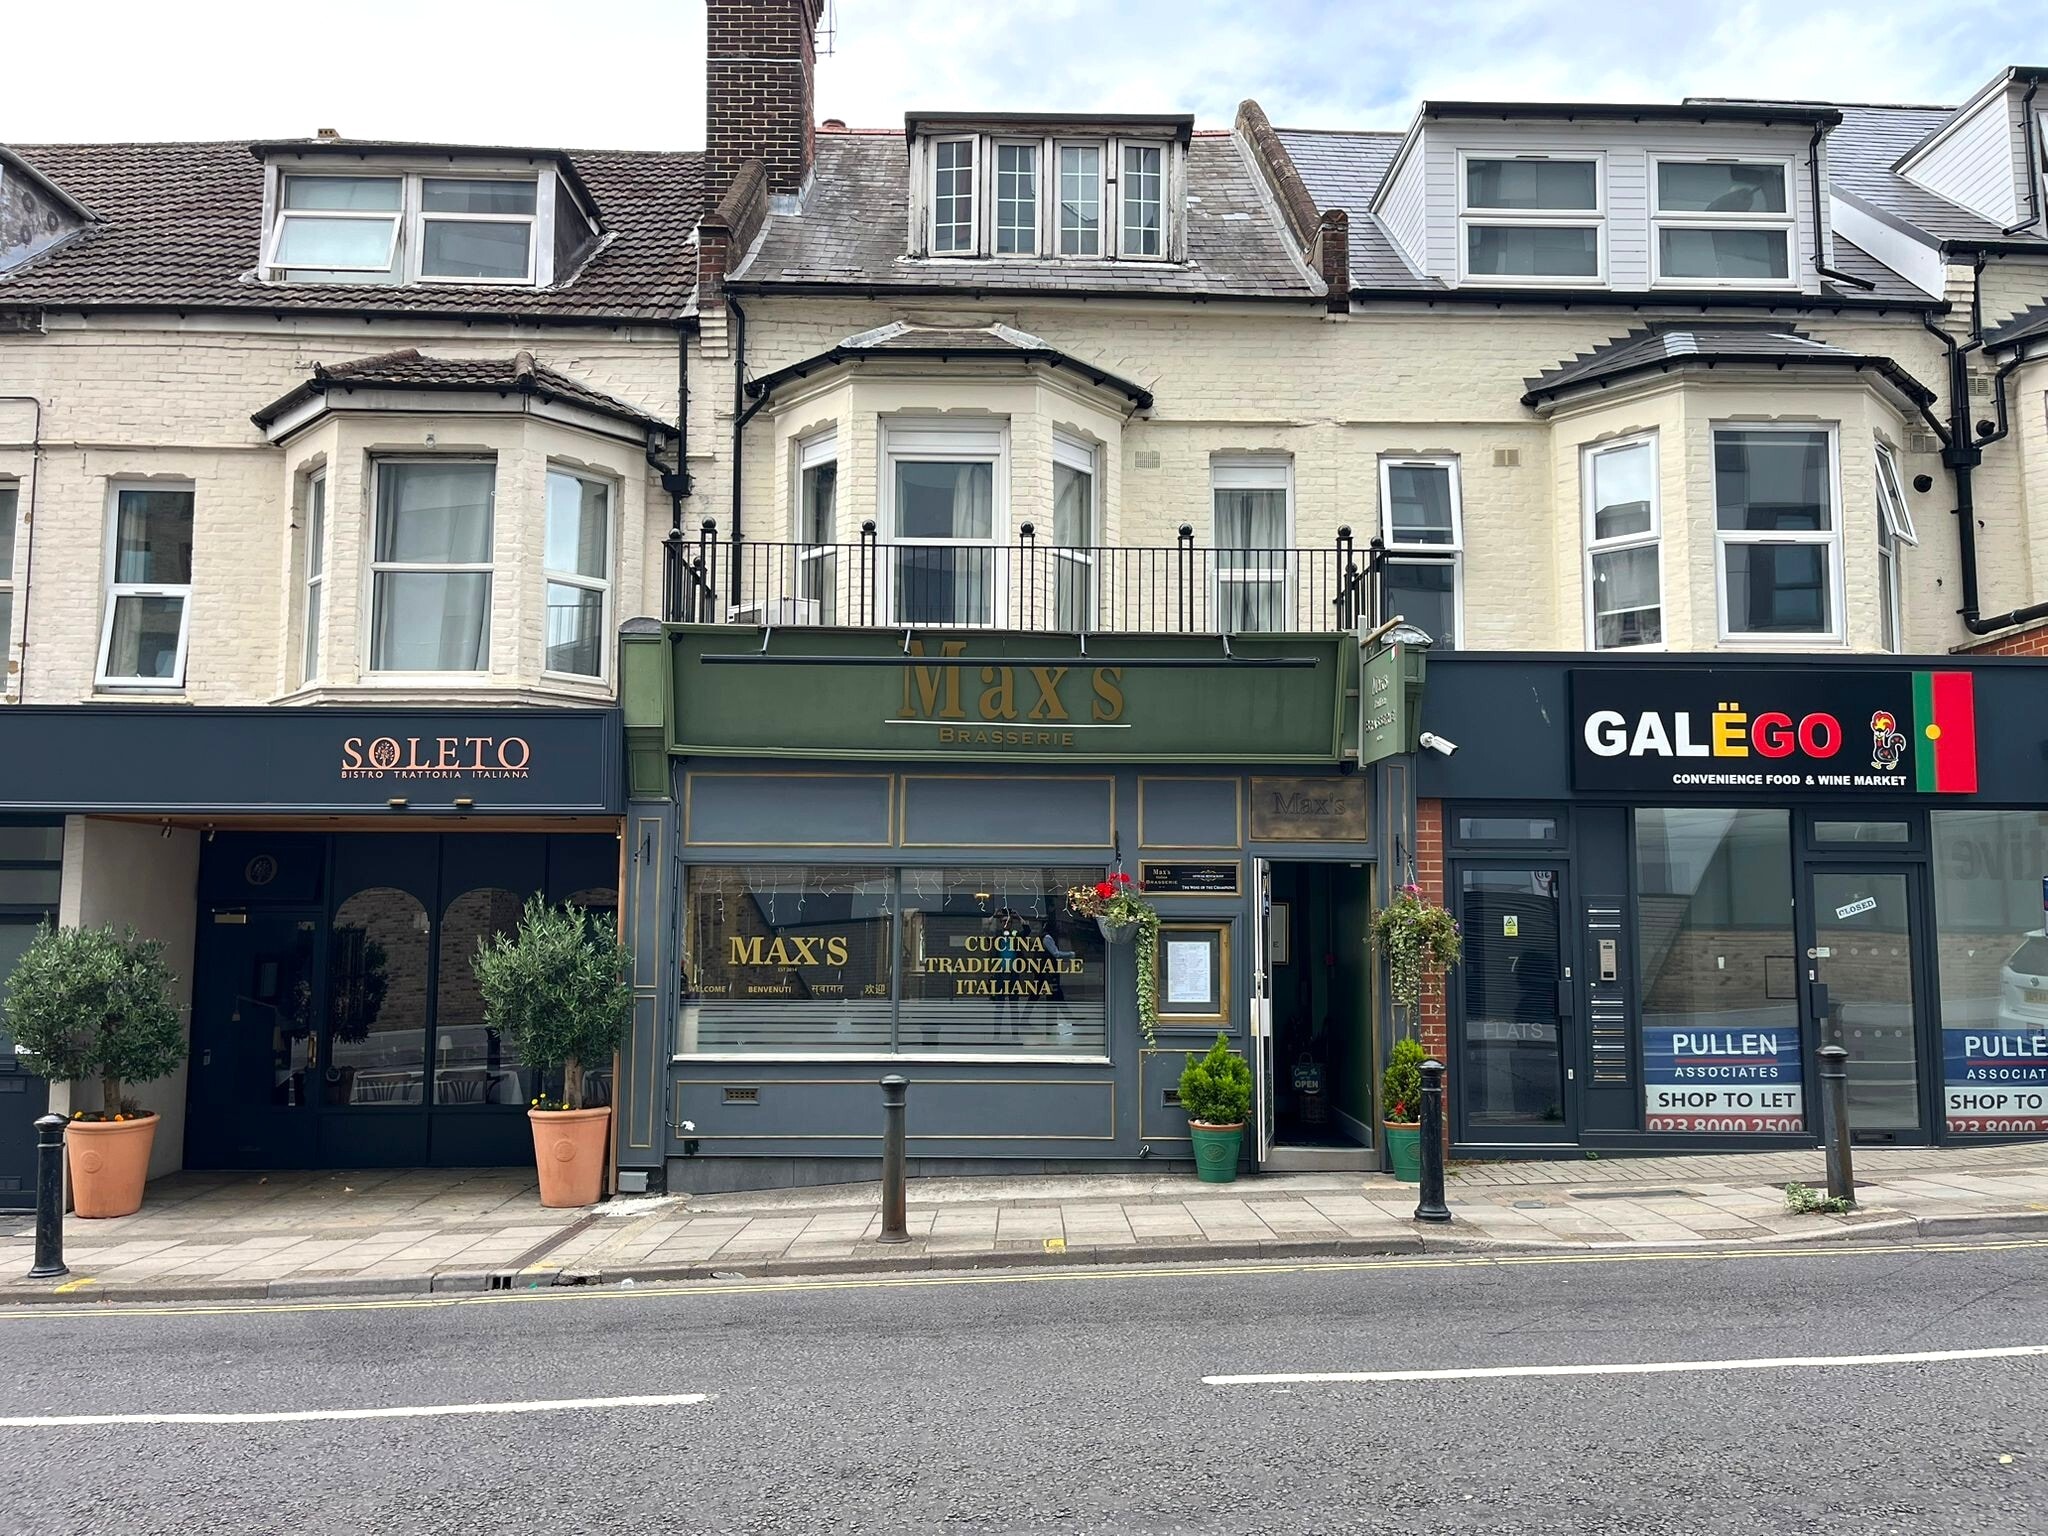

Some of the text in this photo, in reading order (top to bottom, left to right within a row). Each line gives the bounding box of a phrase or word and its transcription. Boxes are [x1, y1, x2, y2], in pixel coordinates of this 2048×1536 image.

[939, 727, 1074, 746] BRASSERIE
[1584, 702, 1842, 758] GALËGO
[342, 736, 530, 769] SOLETO
[341, 771, 529, 779] BISTRO TRATTORIA ITALIANA
[1672, 774, 1907, 786] CONVENIENCE FOOD & WINE MARKET
[1271, 792, 1346, 815] Max's
[1838, 900, 1875, 917] CLOSED
[728, 936, 849, 966] MAX'S
[964, 936, 1045, 952] CUCINA
[925, 957, 1084, 974] TRADIZIONALE
[1508, 956, 1520, 973] 7
[689, 985, 726, 993] WELCOME
[748, 985, 793, 993] BENVENUTI
[956, 980, 1053, 995] ITALIANA
[1483, 1023, 1544, 1039] FLATS
[1672, 1033, 1778, 1056] PULLEN
[1674, 1066, 1779, 1078] ASSOCIATES
[1966, 1068, 2047, 1080] ASSOCIAT
[1294, 1080, 1319, 1088] OPEN
[1658, 1092, 1797, 1108] SHOP TO LET
[1950, 1094, 2043, 1109] SHOP TO
